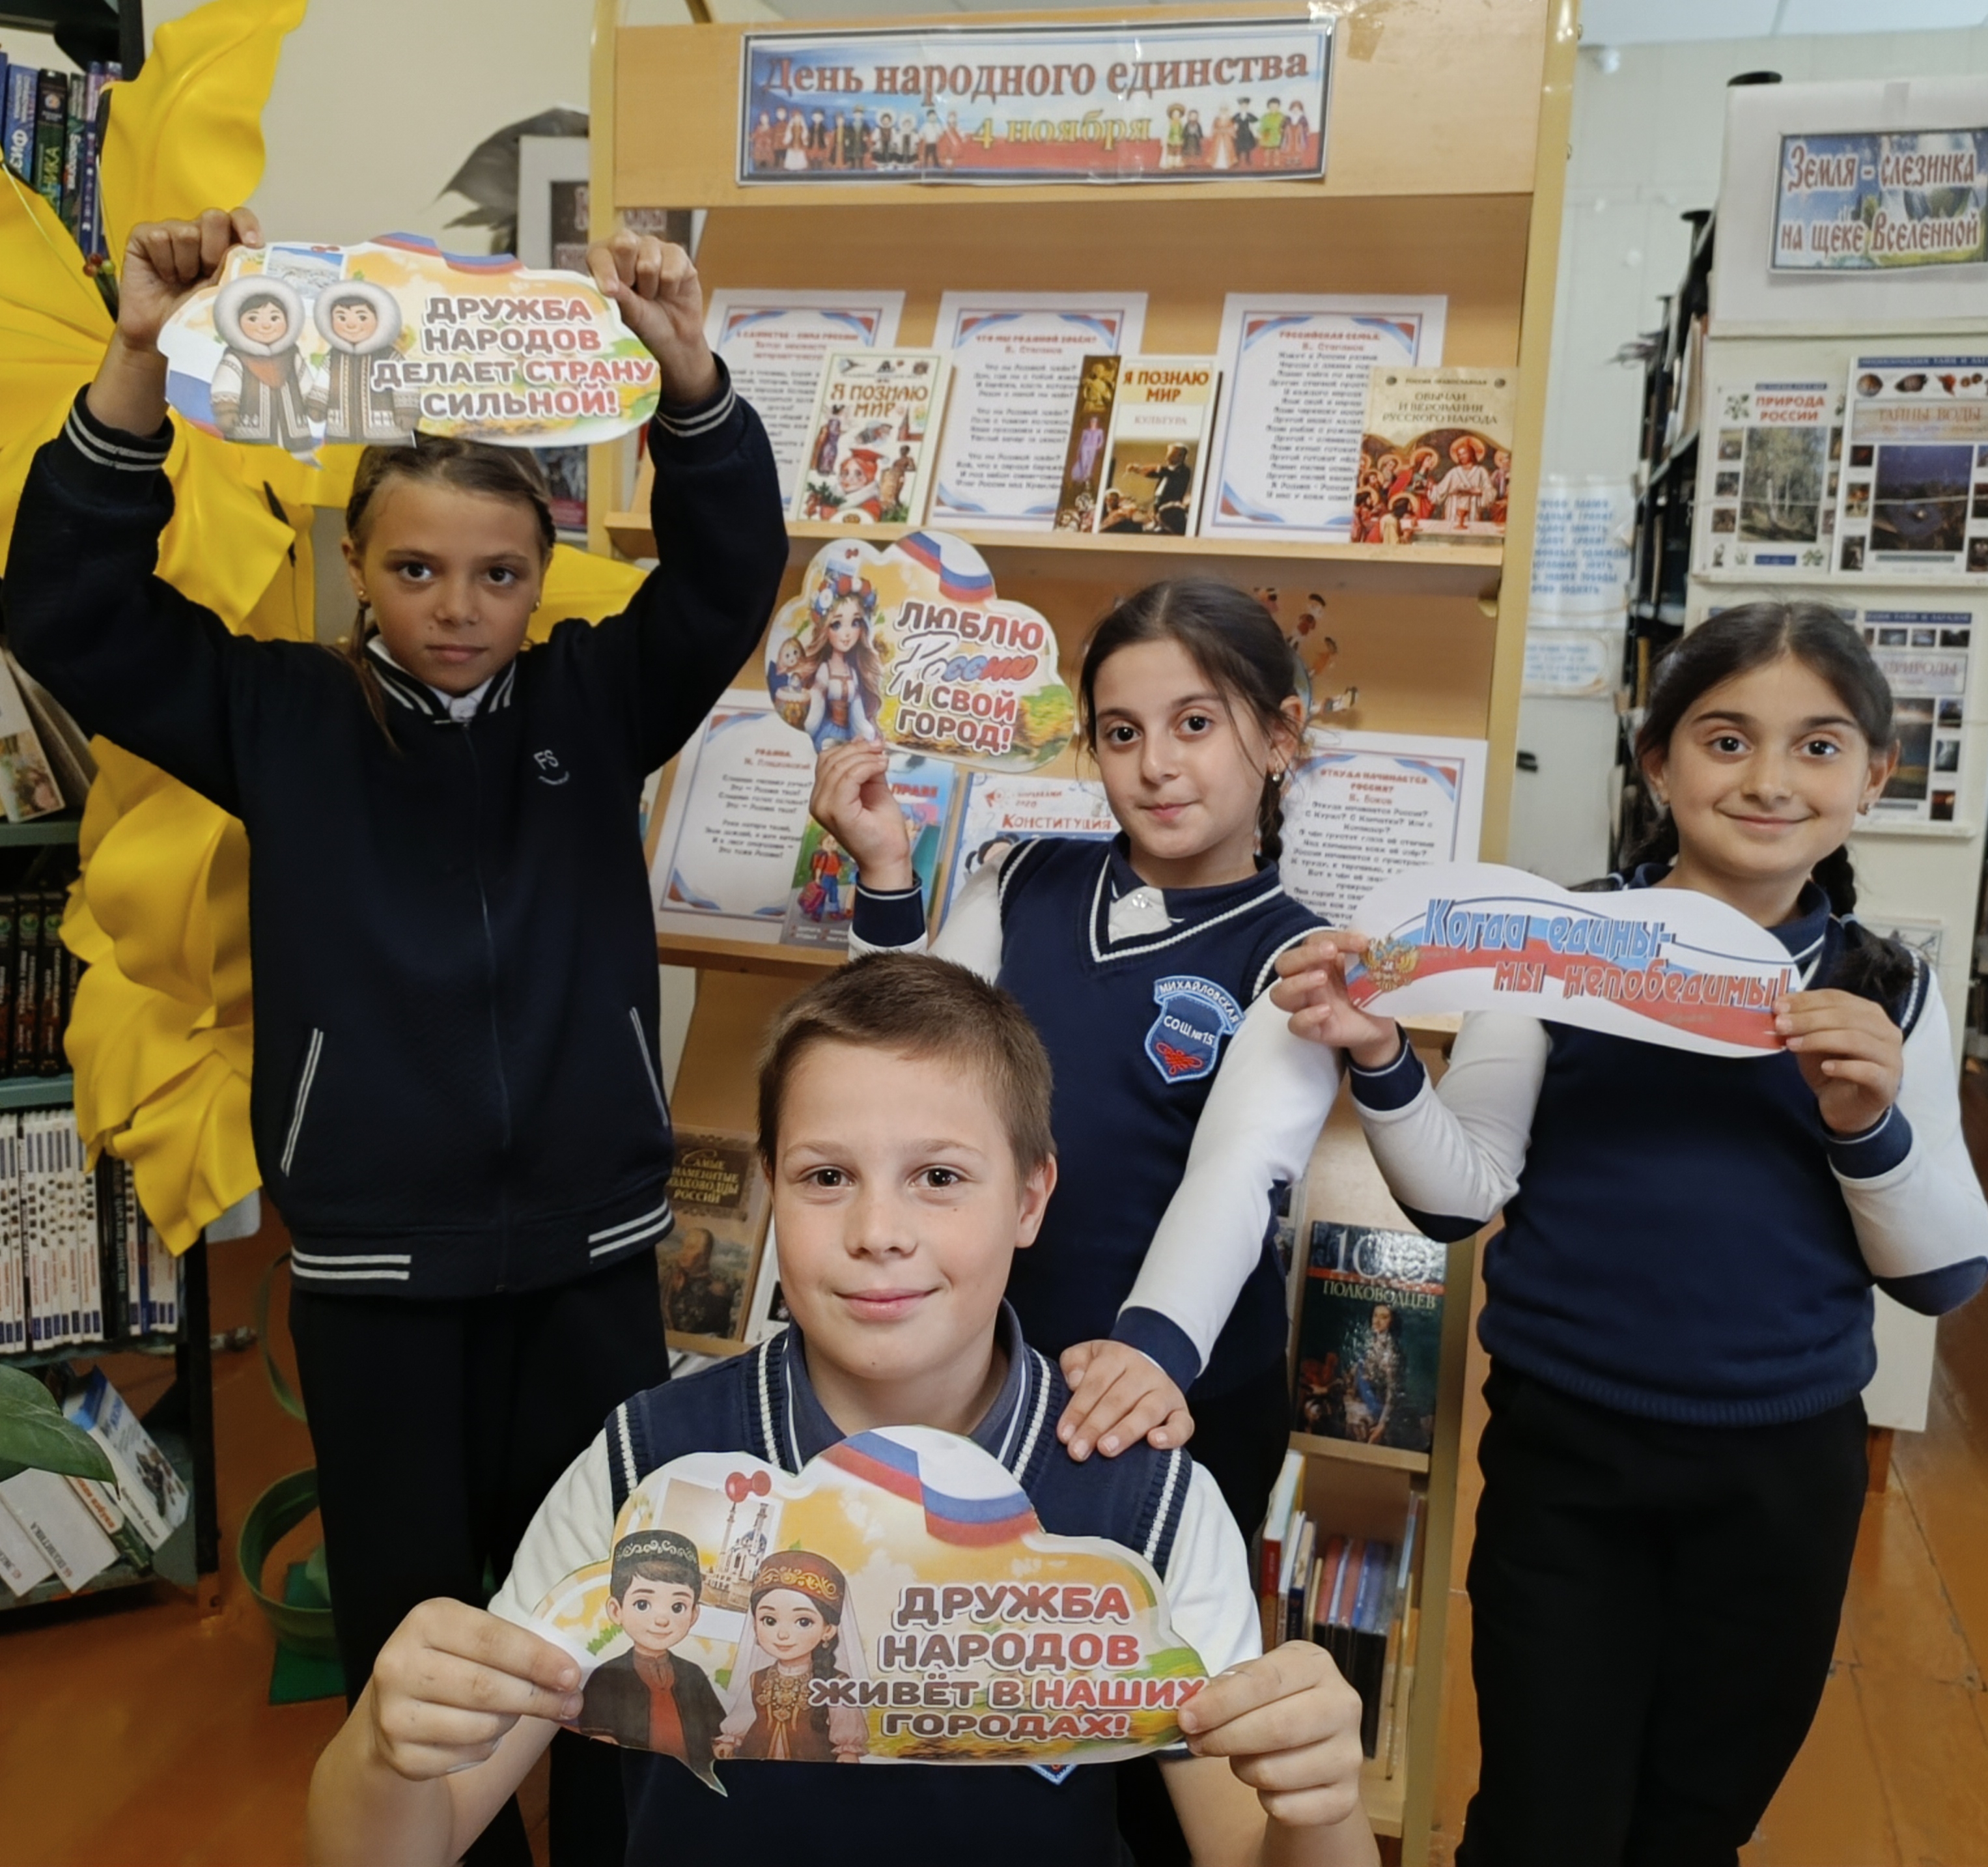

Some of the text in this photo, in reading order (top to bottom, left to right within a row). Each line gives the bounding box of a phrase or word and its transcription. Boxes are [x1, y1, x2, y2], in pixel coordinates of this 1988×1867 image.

[762, 52, 1309, 107] День народного единства
[972, 109, 1151, 150] 4 ноября
[426, 297, 592, 324] ДРУЖБА
[424, 328, 601, 354] НАРОДОВ
[373, 360, 655, 389] ДЕЛАЕТ СТРАНУ
[1123, 370, 1210, 386] Я ПОЗНАЮ
[422, 386, 619, 417] СИЛЬНОЙ!
[830, 383, 929, 402] Я ПОЗНАЮ
[1145, 387, 1182, 403] МИР
[1755, 395, 1825, 408] ПРИРОДА
[854, 402, 896, 418] МИР
[1134, 415, 1188, 425] КУЛЬТУРА
[1382, 412, 1498, 425] РУССКОГО НАРОДА
[1398, 402, 1484, 413] И ВЕРОВАНИЯ
[1760, 410, 1818, 423] РОССИИ
[897, 601, 1044, 651] ЛЮБЛЮ
[887, 630, 1039, 694] Россию
[902, 679, 1016, 722] И СВОЙ
[897, 709, 1013, 753] ГОРОД!
[1320, 768, 1428, 785] ОТКУДА НАЧИНАЕТСЯ
[1351, 782, 1395, 793] РОССИЯ?
[1422, 897, 1532, 952] Когда
[1492, 958, 1791, 1009] мы непобедимы!
[1158, 980, 1240, 1024] МИХАЙЛОВСКАЯ
[673, 1188, 721, 1204] РОССИИ
[1323, 1279, 1437, 1310] ПОЛКОВОДЦЕВ
[896, 1586, 1130, 1627] ДРУЖБА
[882, 1633, 1140, 1671] НАРОДОВ
[811, 1672, 1205, 1707] ЖИВЁТ В НАШИХ
[885, 1713, 1129, 1741] ГОРОДАХ!
